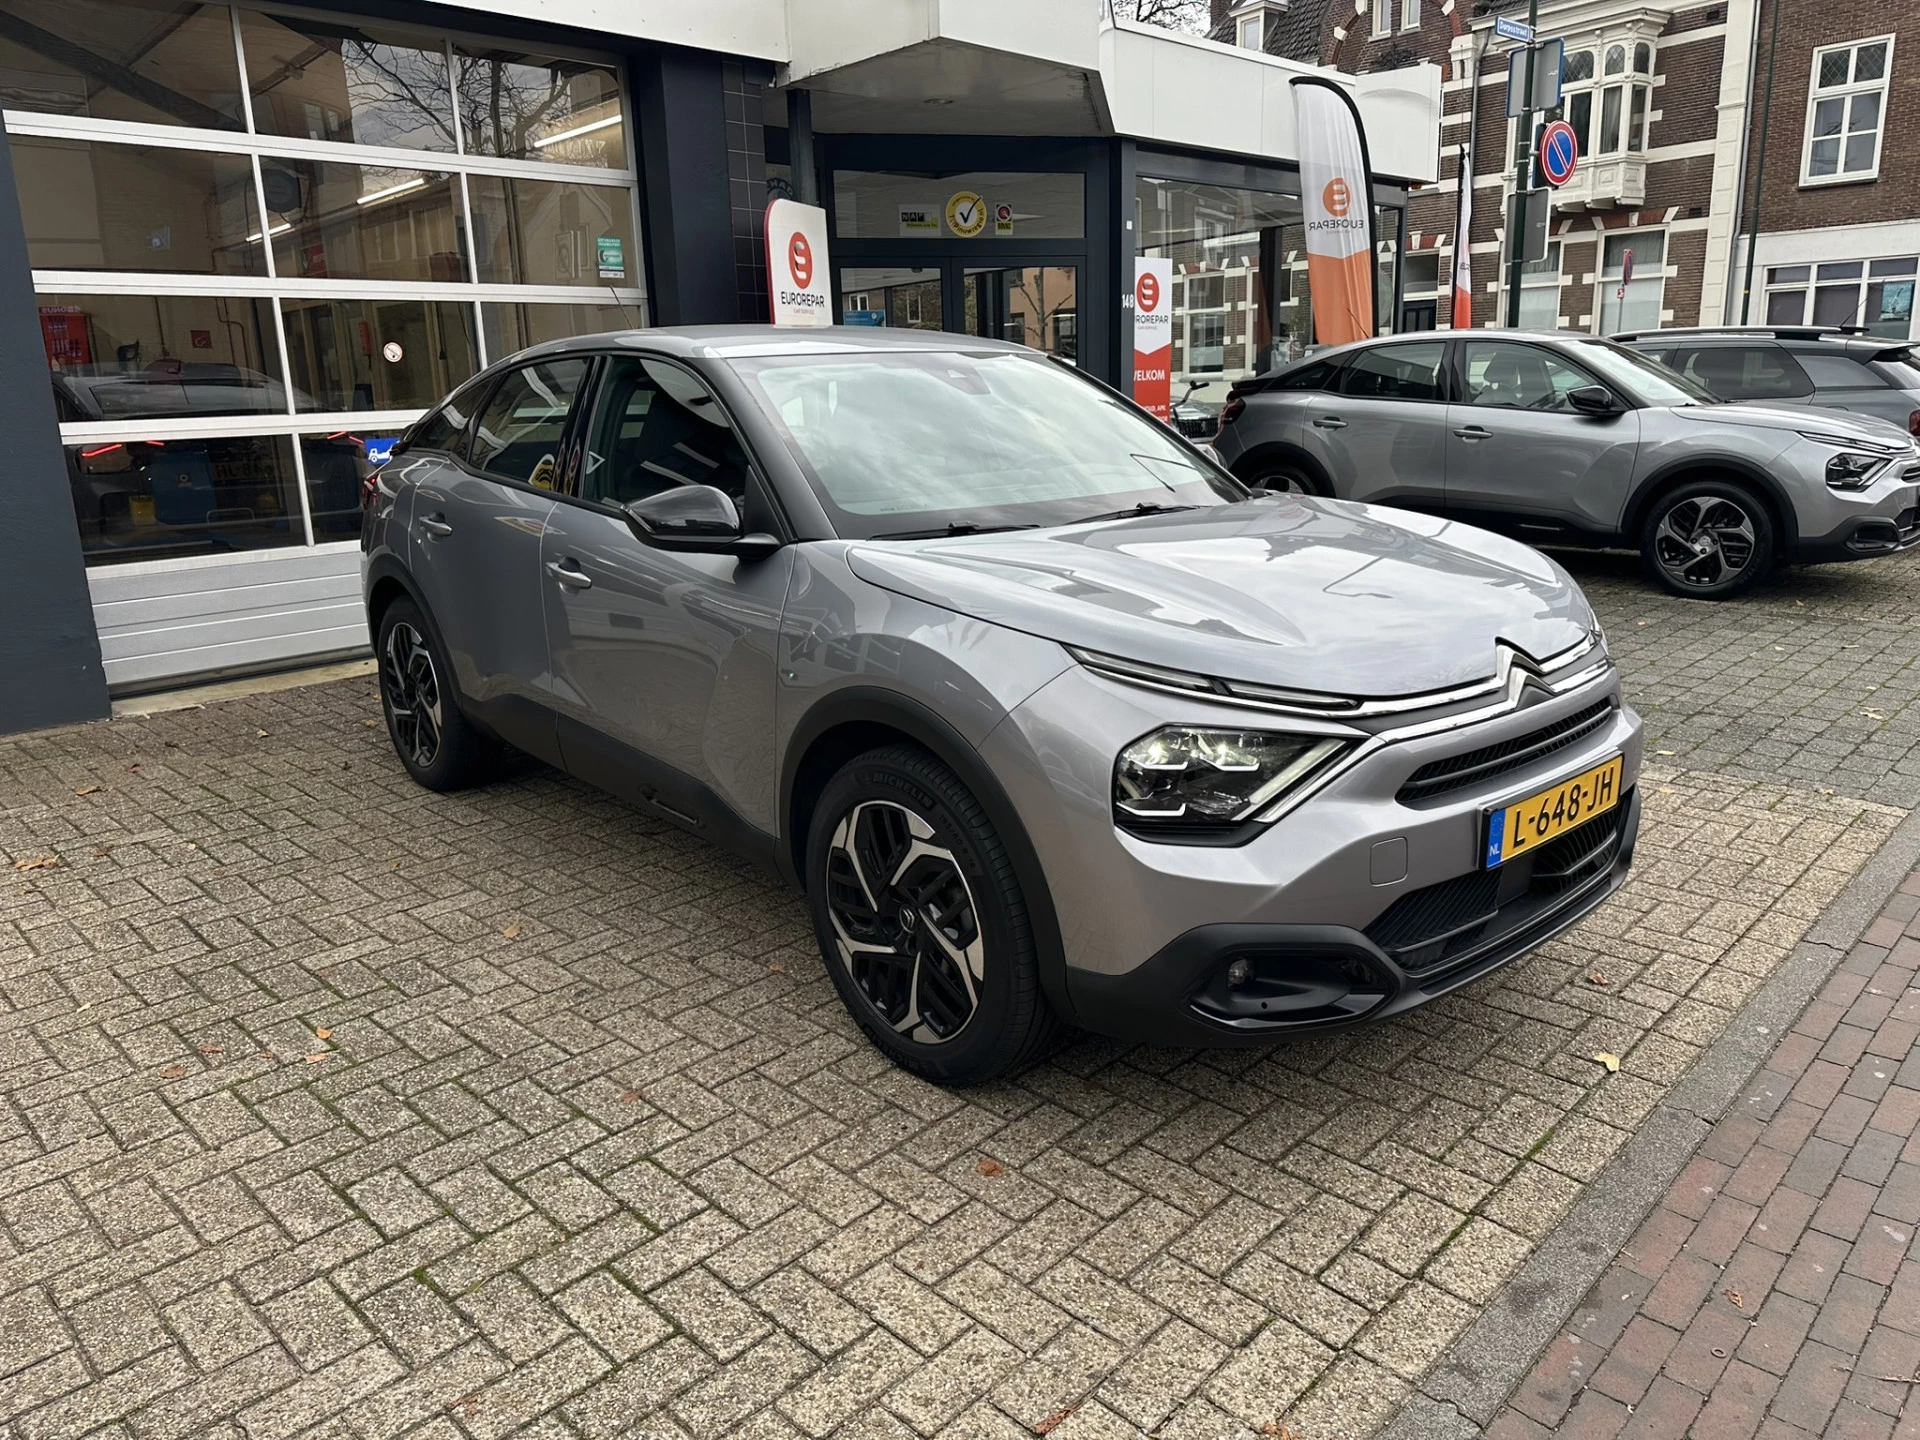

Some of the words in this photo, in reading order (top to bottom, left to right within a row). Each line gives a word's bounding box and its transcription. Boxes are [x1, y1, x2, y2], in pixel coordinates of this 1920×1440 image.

[781, 291, 825, 308] EUROREPAR
[1122, 294, 1134, 308] 148
[872, 772, 934, 808] MICHELIN
[1513, 766, 1614, 849] L-648-JH
[1489, 843, 1500, 857] NL
